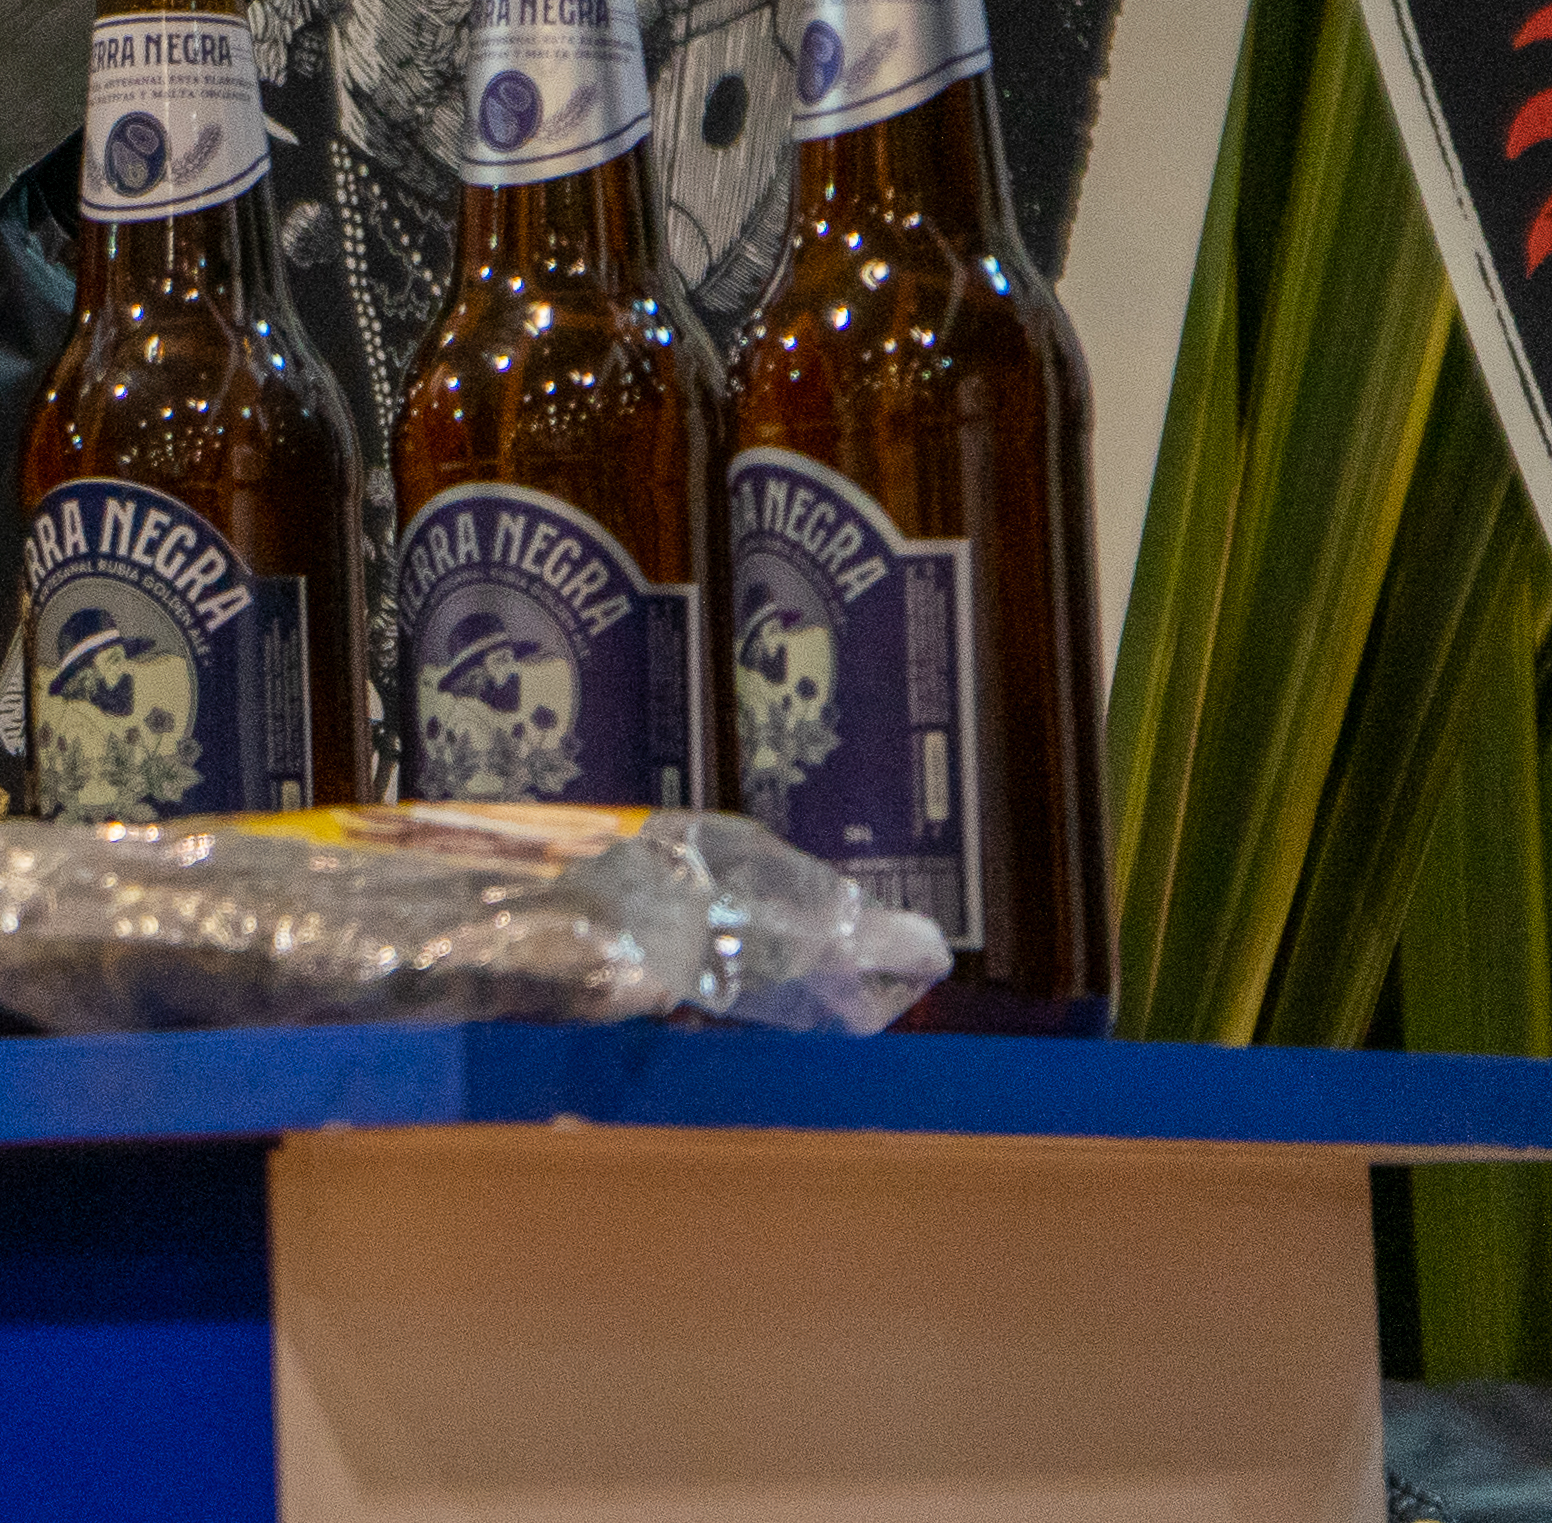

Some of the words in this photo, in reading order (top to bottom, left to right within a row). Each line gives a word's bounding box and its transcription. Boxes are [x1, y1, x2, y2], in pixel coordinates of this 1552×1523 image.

[144, 33, 233, 67] NEGRA
[97, 559, 140, 582] RUBIA
[98, 496, 254, 635] NEGRA
[492, 510, 633, 637] NEGRA
[762, 478, 891, 603] NEGRA
